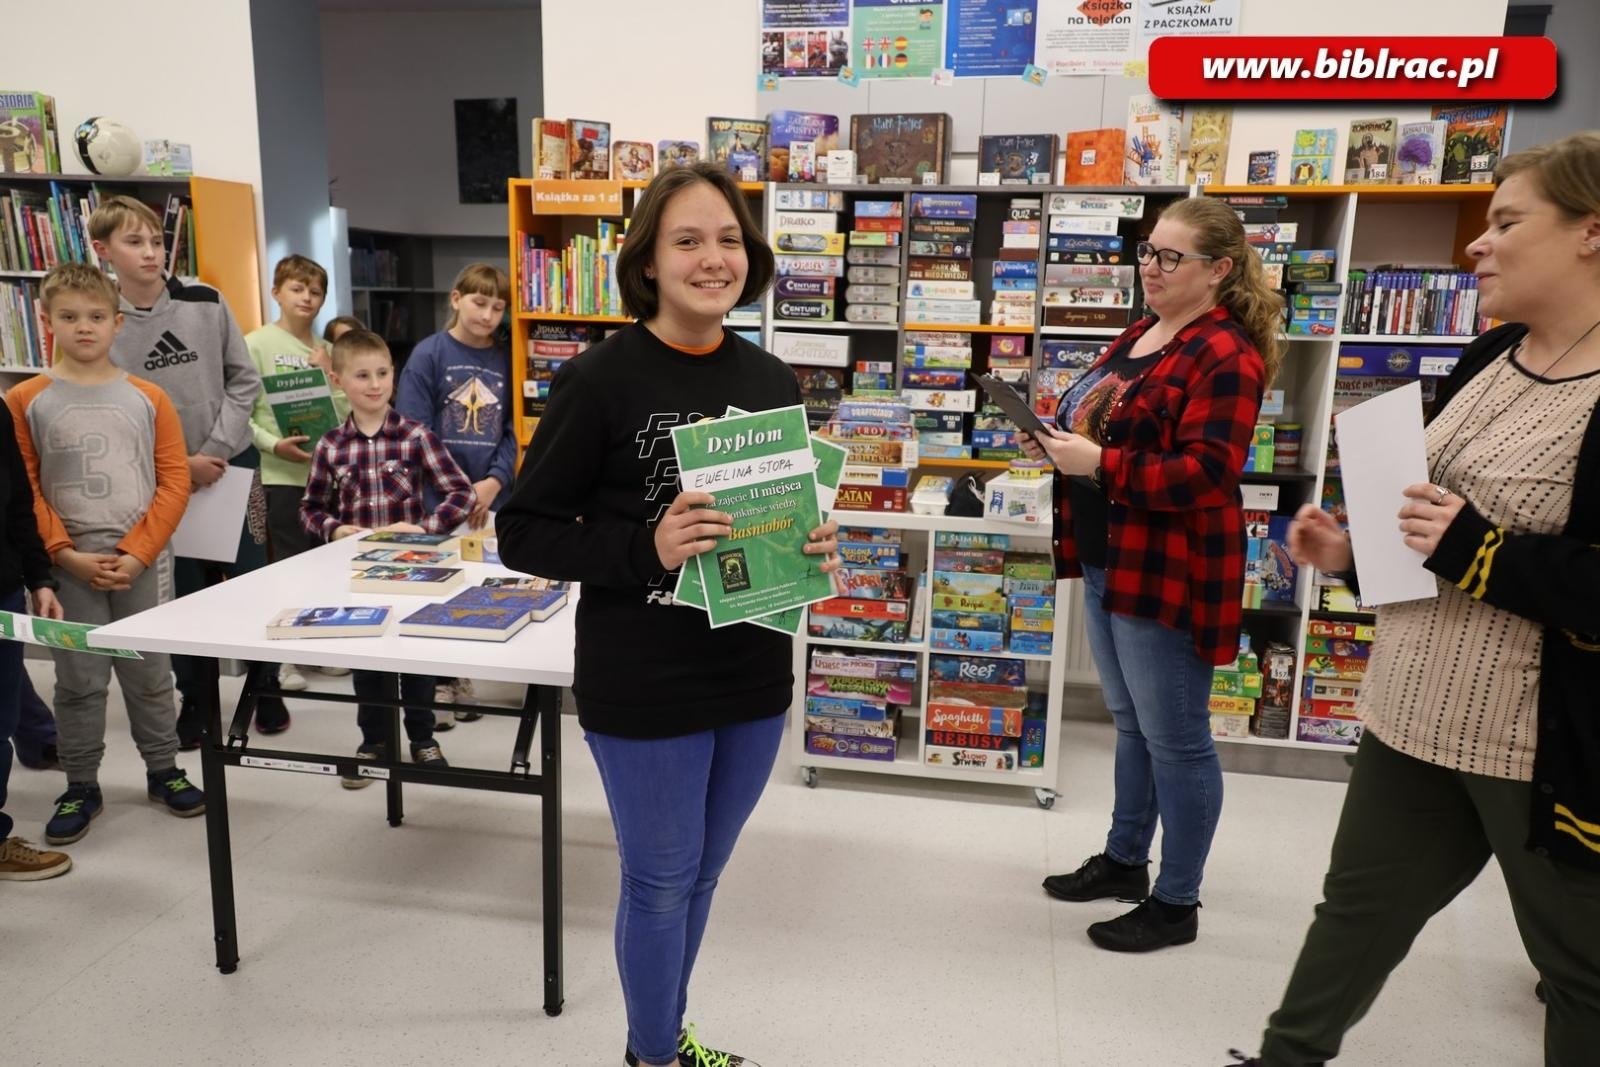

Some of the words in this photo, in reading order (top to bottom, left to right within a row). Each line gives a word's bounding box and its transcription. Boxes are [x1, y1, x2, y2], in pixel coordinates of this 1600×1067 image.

[1167, 4, 1211, 17] KSIĄŻKI
[1067, 16, 1083, 25] na
[1086, 14, 1131, 25] telefon
[1144, 20, 1151, 29] Z
[1153, 17, 1233, 29] PACZKOMATU
[535, 192, 580, 204] Książka
[582, 194, 596, 202] za
[599, 192, 605, 203] 1
[608, 192, 619, 203] zł
[1011, 209, 1031, 219] QUIZ
[786, 280, 820, 291] CENTURY
[781, 303, 820, 315] CENTURY
[144, 350, 199, 371] adidas
[706, 428, 783, 454] Dyplom
[695, 469, 753, 488] EWELINA
[758, 458, 794, 474] STOPA
[717, 493, 748, 508] zajęcie
[761, 481, 802, 499] miejsca
[837, 489, 872, 502] CATAN
[768, 499, 798, 513] wiedzy
[728, 515, 795, 541] Baśniobór
[960, 661, 997, 679] Reef
[933, 708, 985, 727] Spaghetti
